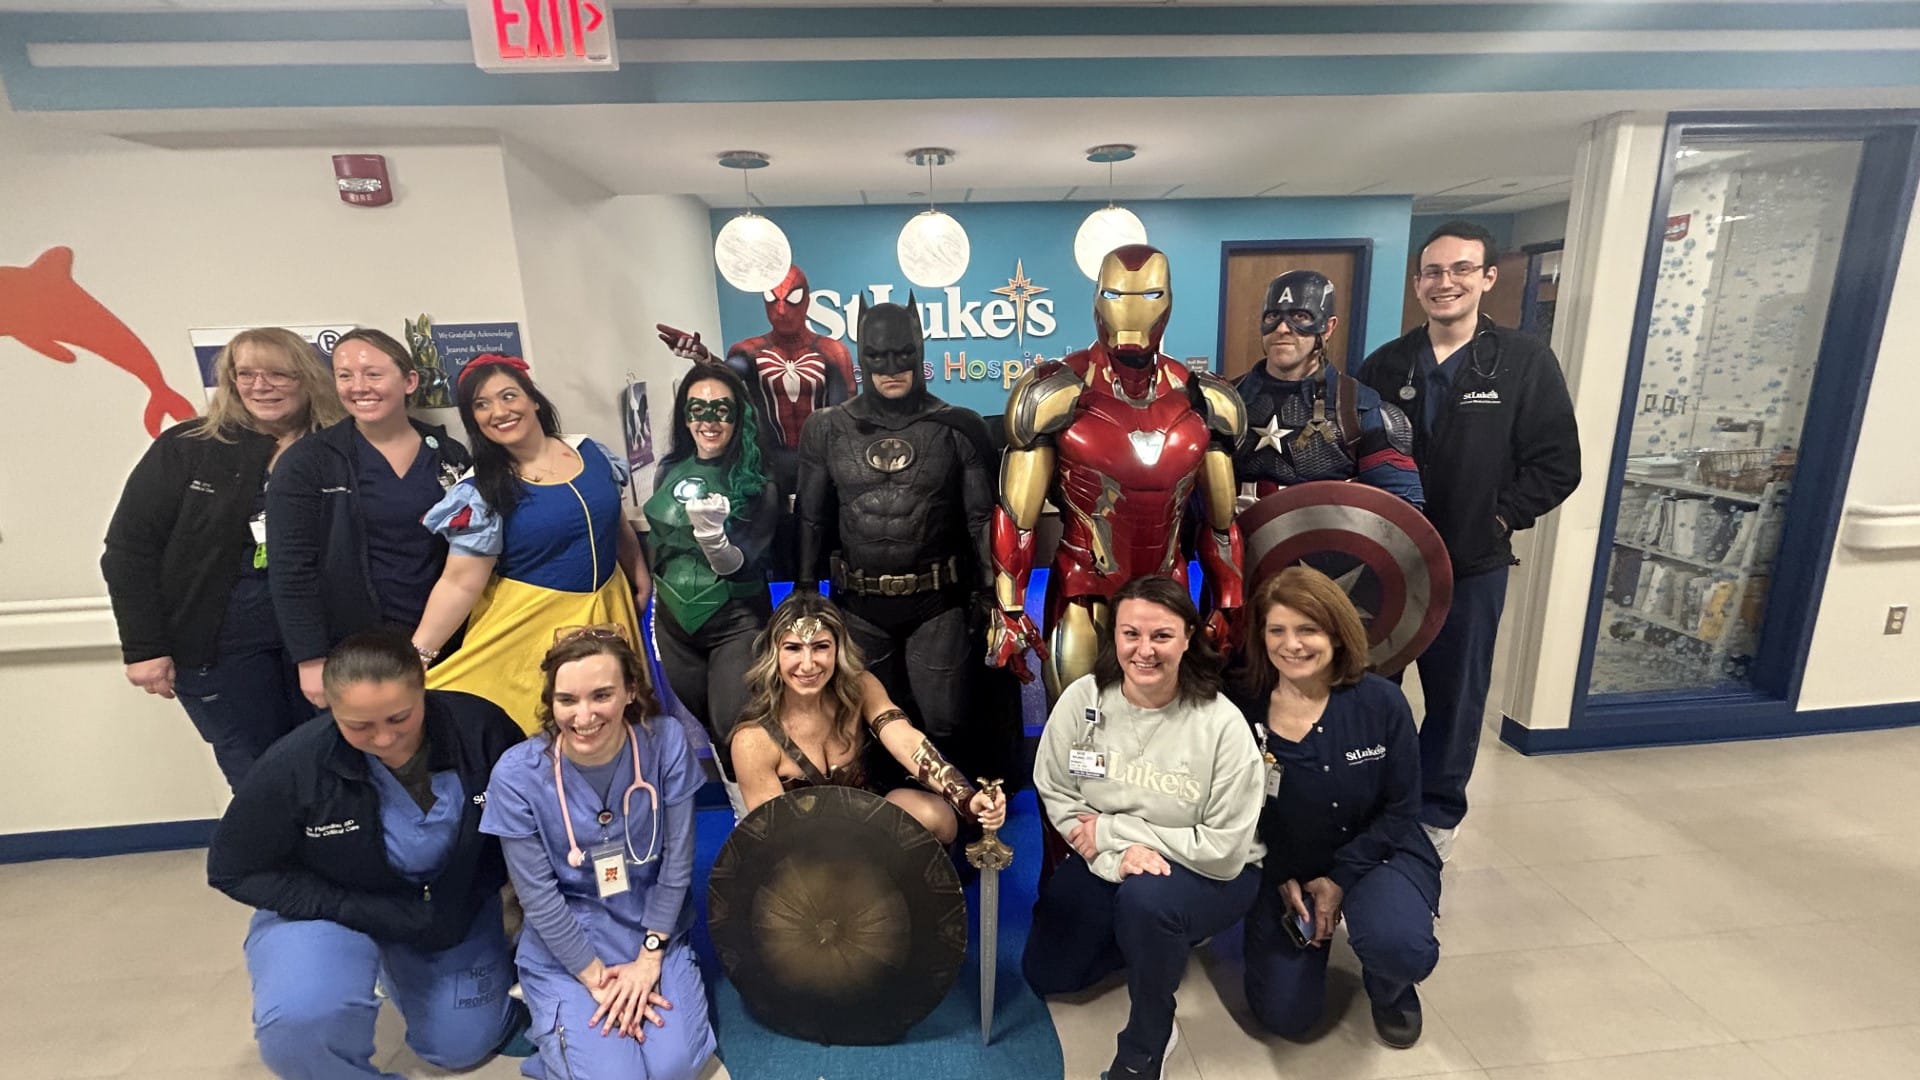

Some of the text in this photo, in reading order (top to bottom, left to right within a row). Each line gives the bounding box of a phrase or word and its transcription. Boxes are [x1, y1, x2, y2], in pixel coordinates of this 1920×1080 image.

[1277, 286, 1294, 304] A
[477, 329, 514, 340] Acknowledge
[476, 343, 504, 353] Richard
